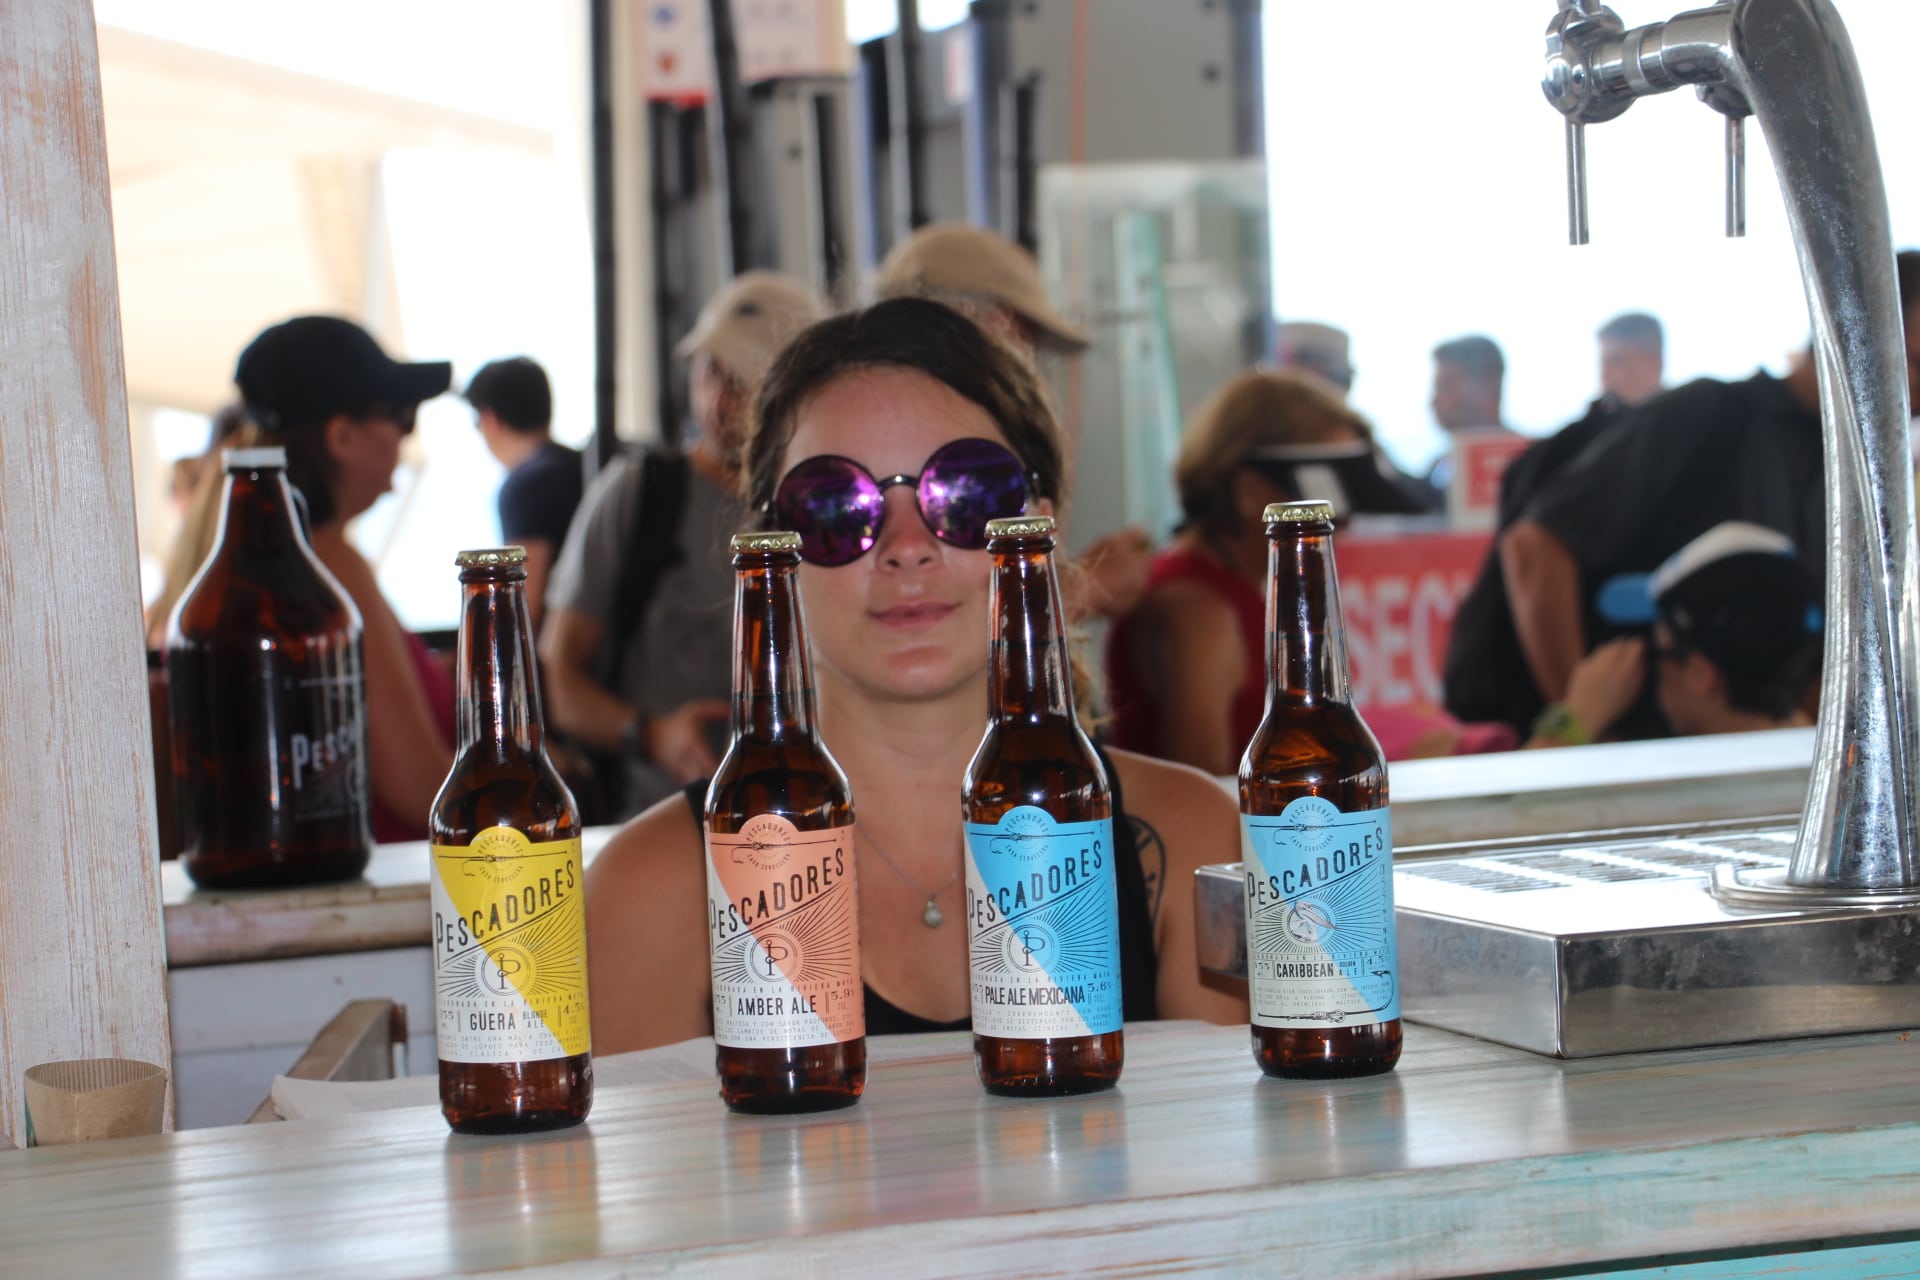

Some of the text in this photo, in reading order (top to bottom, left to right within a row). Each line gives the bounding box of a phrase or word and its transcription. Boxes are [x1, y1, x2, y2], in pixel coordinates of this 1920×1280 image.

[1343, 573, 1470, 707] SEC
[1005, 813, 1049, 833] PESCADORES
[1289, 804, 1334, 823] PESCADORES
[746, 822, 791, 842] PESCADORES
[478, 834, 524, 854] PESCADORES
[1247, 826, 1383, 919] PESCADORES
[710, 847, 844, 955] PESCADORES
[968, 839, 1102, 944] PESCADORES
[435, 859, 574, 970] PESCADORES
[1276, 962, 1334, 978] CARIBBEAN
[1338, 967, 1358, 977] ALE
[737, 997, 784, 1016] AMBER
[791, 994, 817, 1014] ALE
[985, 985, 1006, 1005] PALE
[1007, 987, 1027, 1006] ALE
[1028, 985, 1085, 1006] MEXICANA
[522, 1009, 548, 1020] BLONDE
[527, 1019, 545, 1028] ALE
